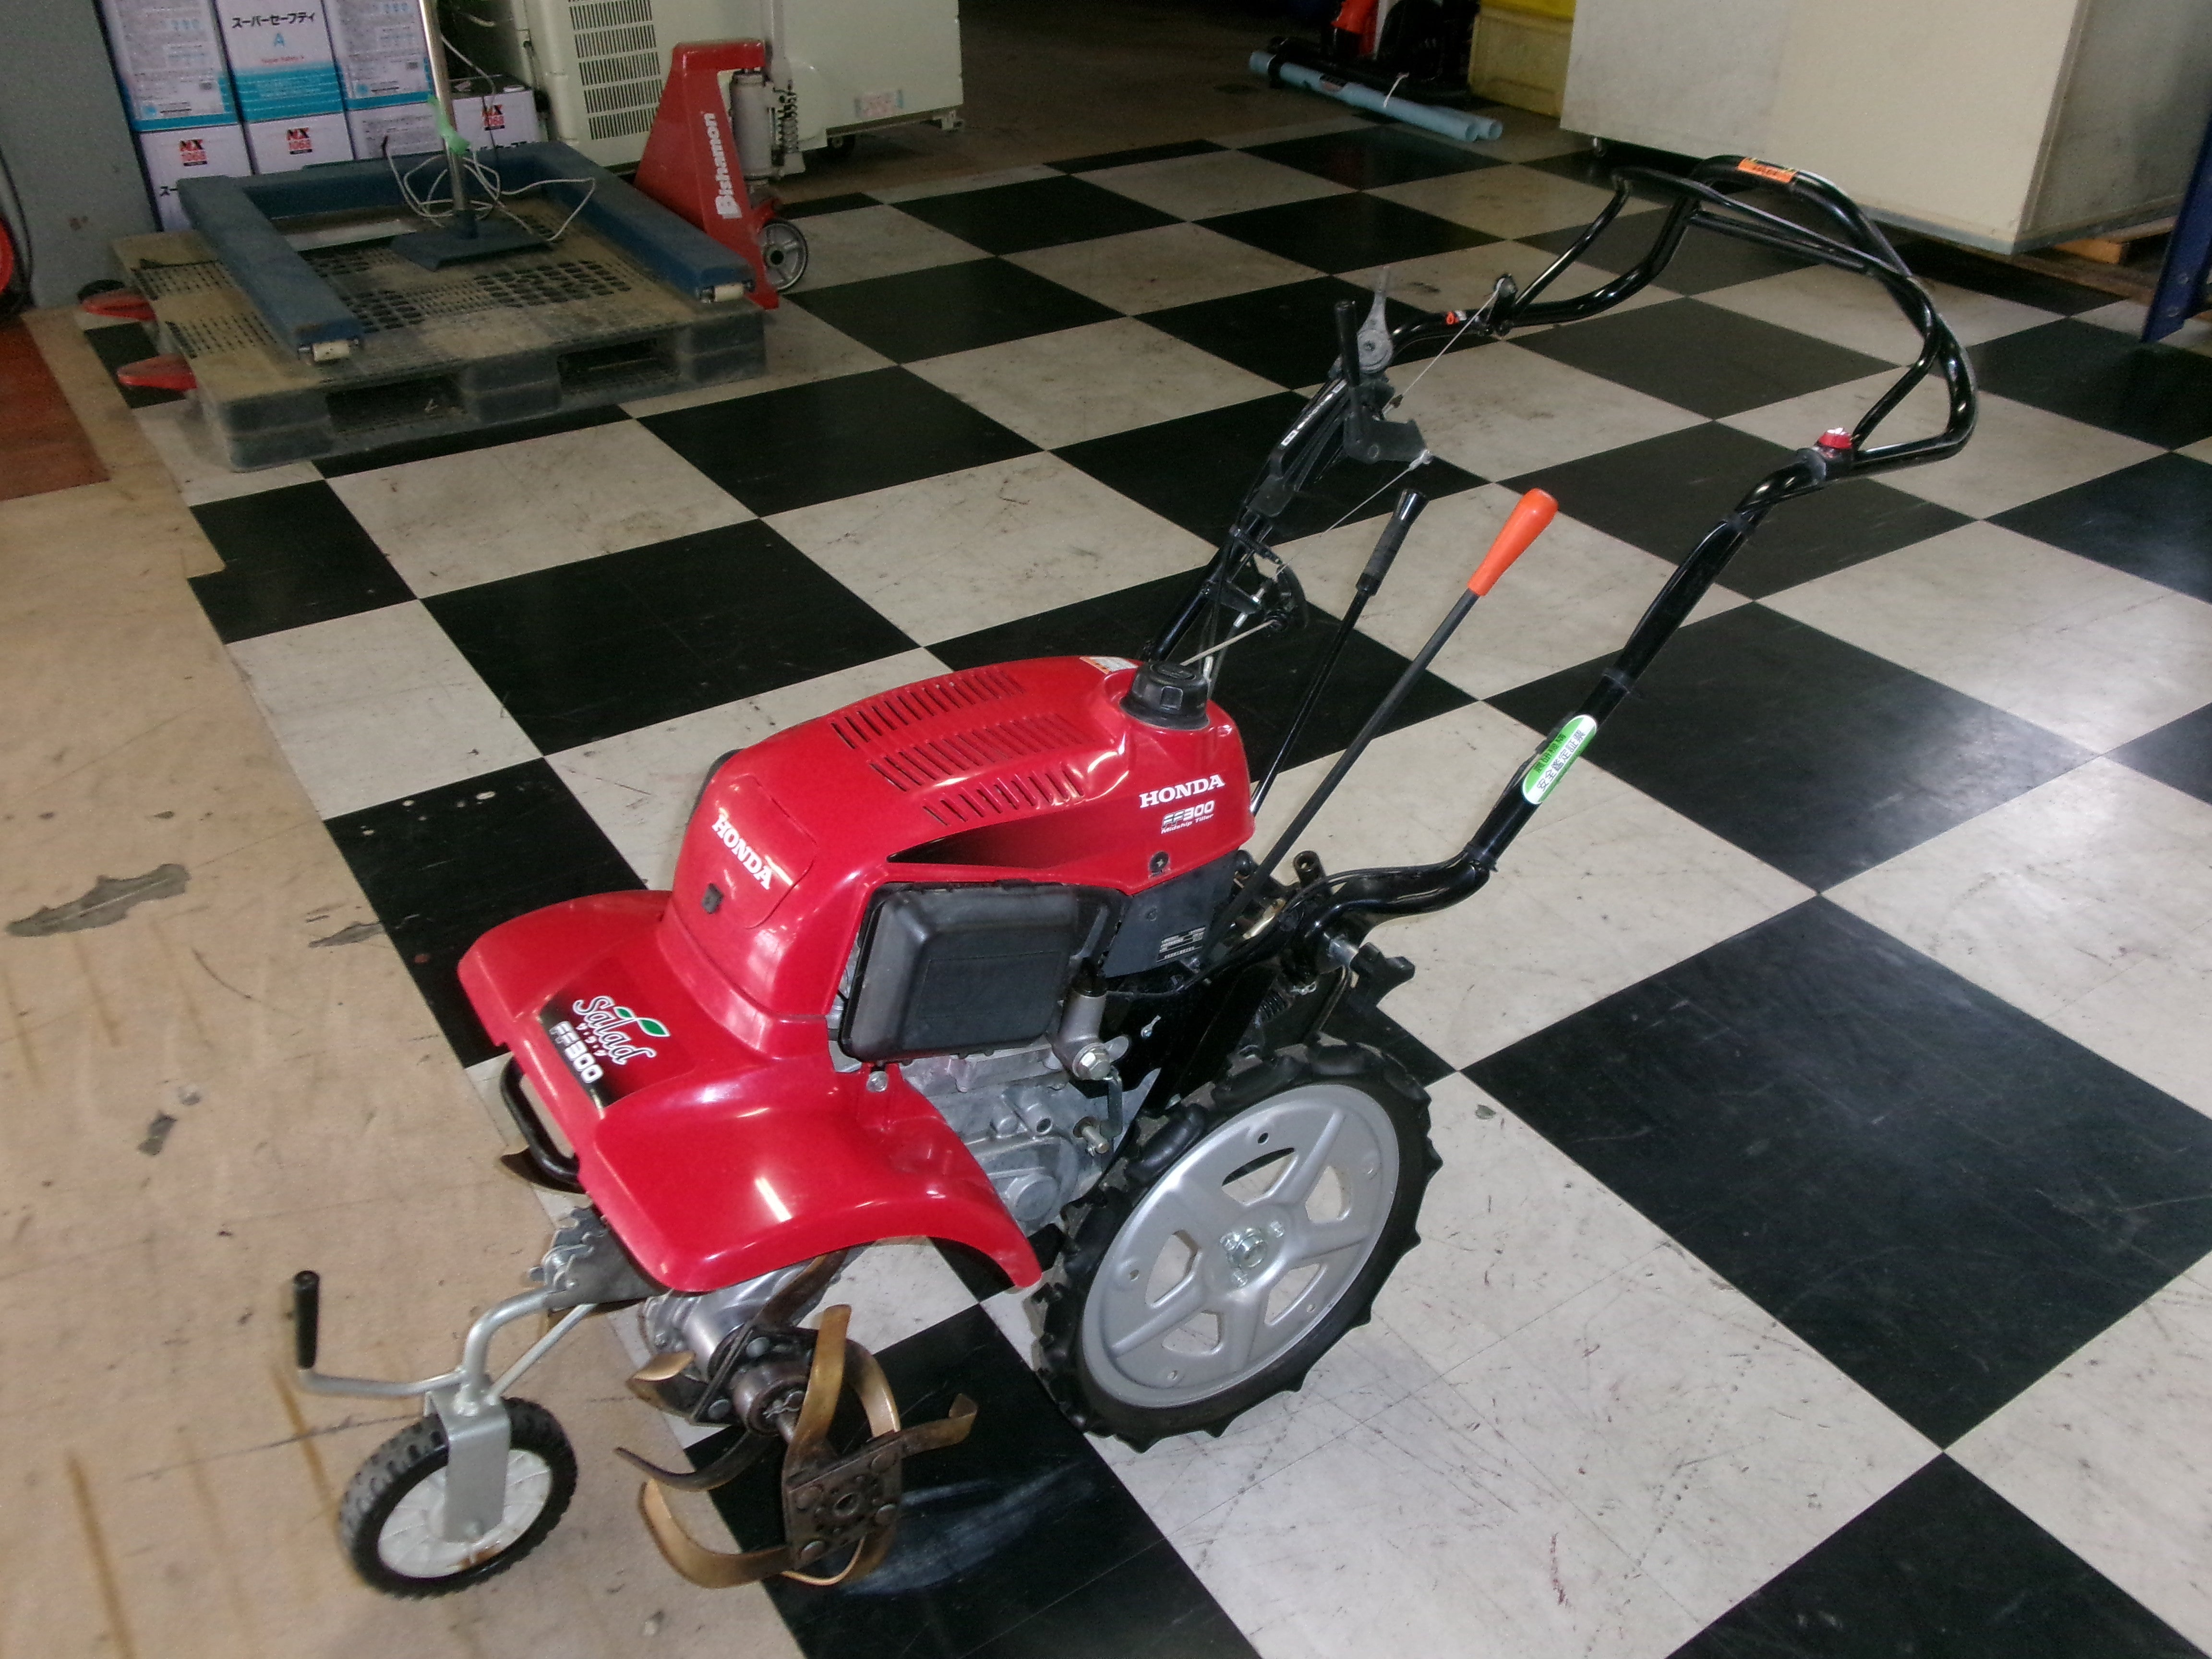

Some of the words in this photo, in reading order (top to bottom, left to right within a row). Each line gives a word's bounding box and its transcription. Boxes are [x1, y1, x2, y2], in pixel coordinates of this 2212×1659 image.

[232, 12, 315, 28] スーパーセーフティ
[273, 32, 285, 47] A
[703, 113, 742, 219] Bishamon
[1537, 729, 1586, 792] 安全鑑定証票
[1139, 774, 1226, 808] HONDA
[1162, 800, 1215, 829] FF300
[1161, 821, 1193, 834] Midship
[1195, 814, 1214, 823] Tiller
[711, 814, 773, 890] HONDA
[549, 1021, 604, 1084] FF300
[572, 995, 657, 1065] Salad
